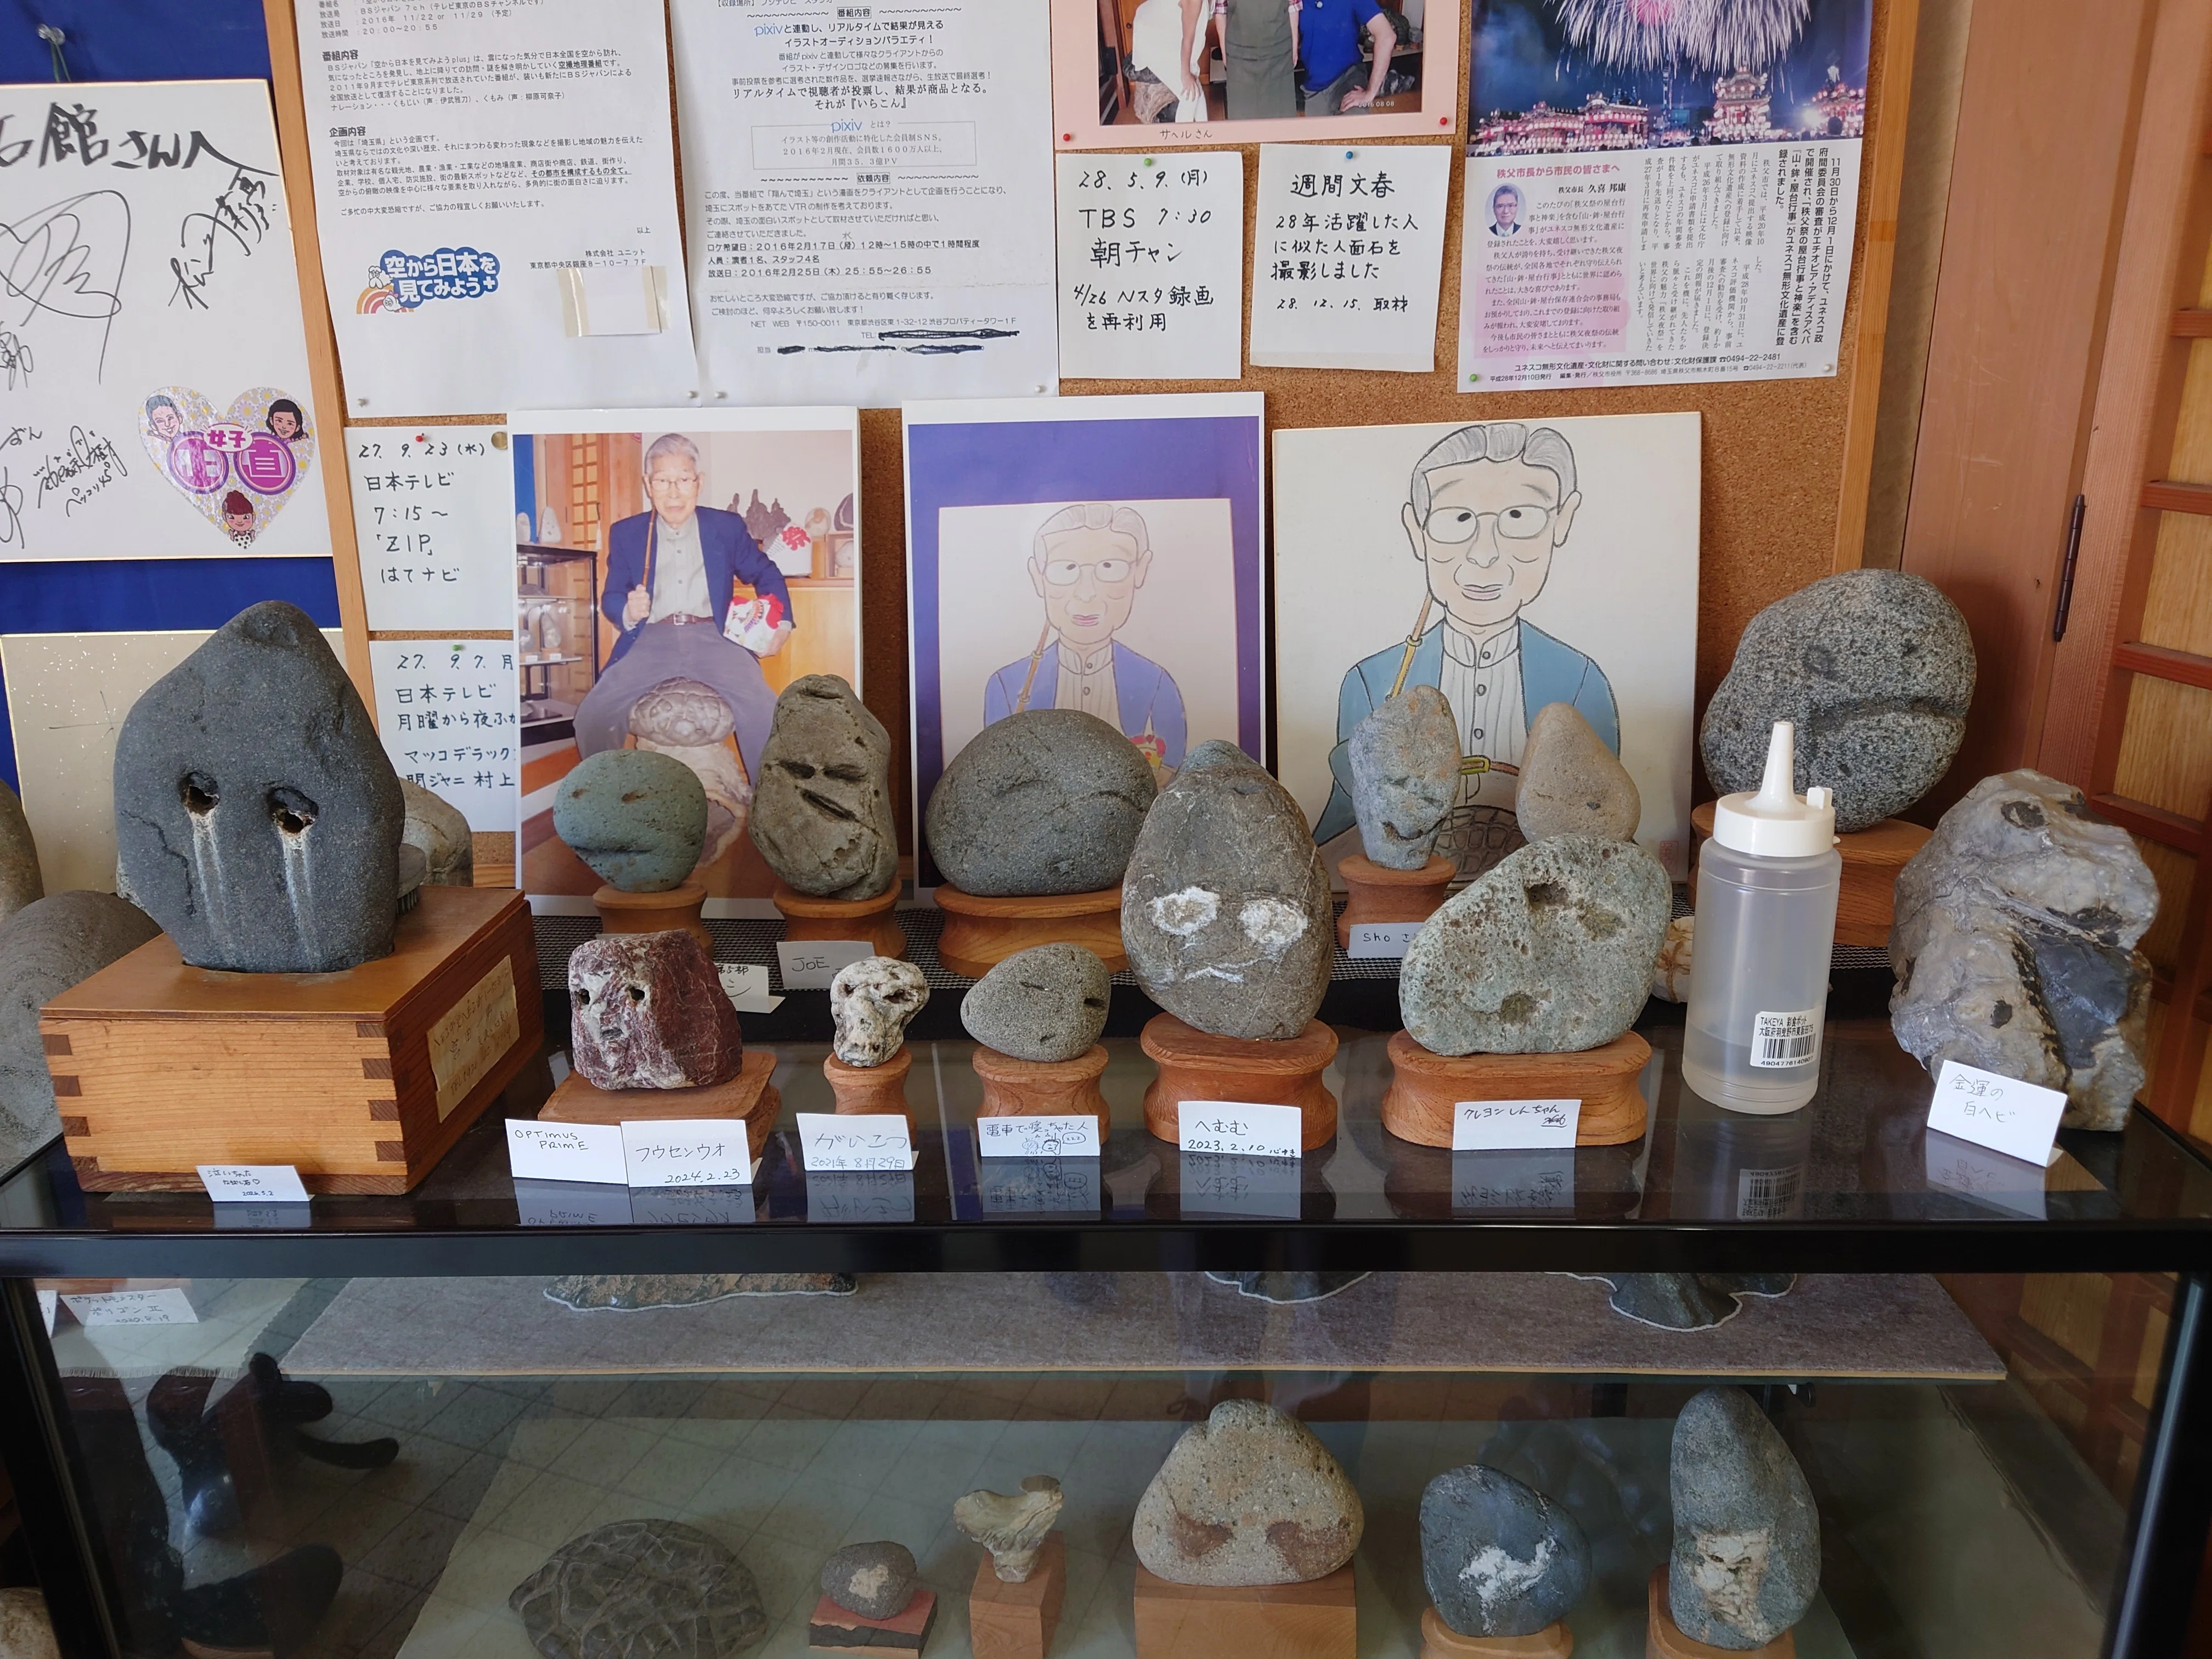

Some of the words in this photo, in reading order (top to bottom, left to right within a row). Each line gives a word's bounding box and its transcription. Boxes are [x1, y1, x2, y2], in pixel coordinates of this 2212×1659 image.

[319, 10, 340, 19] 放送局
[838, 7, 870, 18] 番組内容
[321, 30, 348, 38] 放送時間
[785, 35, 932, 48] イラストオーディションバラエティ！
[322, 49, 358, 61] 番組内容
[734, 83, 987, 99] リアルタイムで視聴者が投票し、結果が商品となる。
[815, 98, 906, 110] それが『いらこん』
[329, 126, 366, 137] 企画内容
[831, 119, 862, 133] pixiv
[1160, 128, 1212, 140] サヘルさん
[334, 134, 441, 147] 今回は「埼玉県」という企画です。
[336, 157, 401, 167] いと考えております。
[857, 174, 889, 183] 依頼内容
[1497, 164, 1620, 178] 秩父市長から市民の皆さまへ
[1775, 149, 1788, 209] 録されました。
[1290, 173, 1396, 198] 週間文春
[1588, 184, 1606, 193] 久喜
[1609, 183, 1627, 192] 邦康
[1079, 208, 1136, 229] TBS
[1159, 208, 1211, 226] 7:30
[1276, 213, 1419, 233] 28年活躍した人
[707, 230, 806, 239] ご連絡させていただきました。
[1090, 238, 1184, 268] 朝チャン
[1274, 239, 1401, 256] に似た人面石を
[385, 252, 496, 278] 空から日本を
[1270, 262, 1380, 281] 撮影しました
[1074, 284, 1107, 308] 4/26
[1373, 297, 1409, 313] 取材
[1087, 313, 1167, 332] を再利用
[1490, 374, 1551, 382] 平成28年12月10日発行
[207, 430, 246, 448] 女子
[364, 471, 454, 492] 日本テレビ
[381, 567, 460, 584] はてナビ
[396, 684, 496, 703] 日本テレビ
[404, 746, 516, 764] マツコデラック
[473, 771, 515, 788] 村上
[1760, 1017, 1784, 1026] TAKEYA
[1760, 1056, 1813, 1066] 4904776140907
[1949, 1074, 2004, 1101] 金運の
[1964, 1101, 2016, 1122] 白ヘビ
[635, 1143, 726, 1162] フウセンウオ
